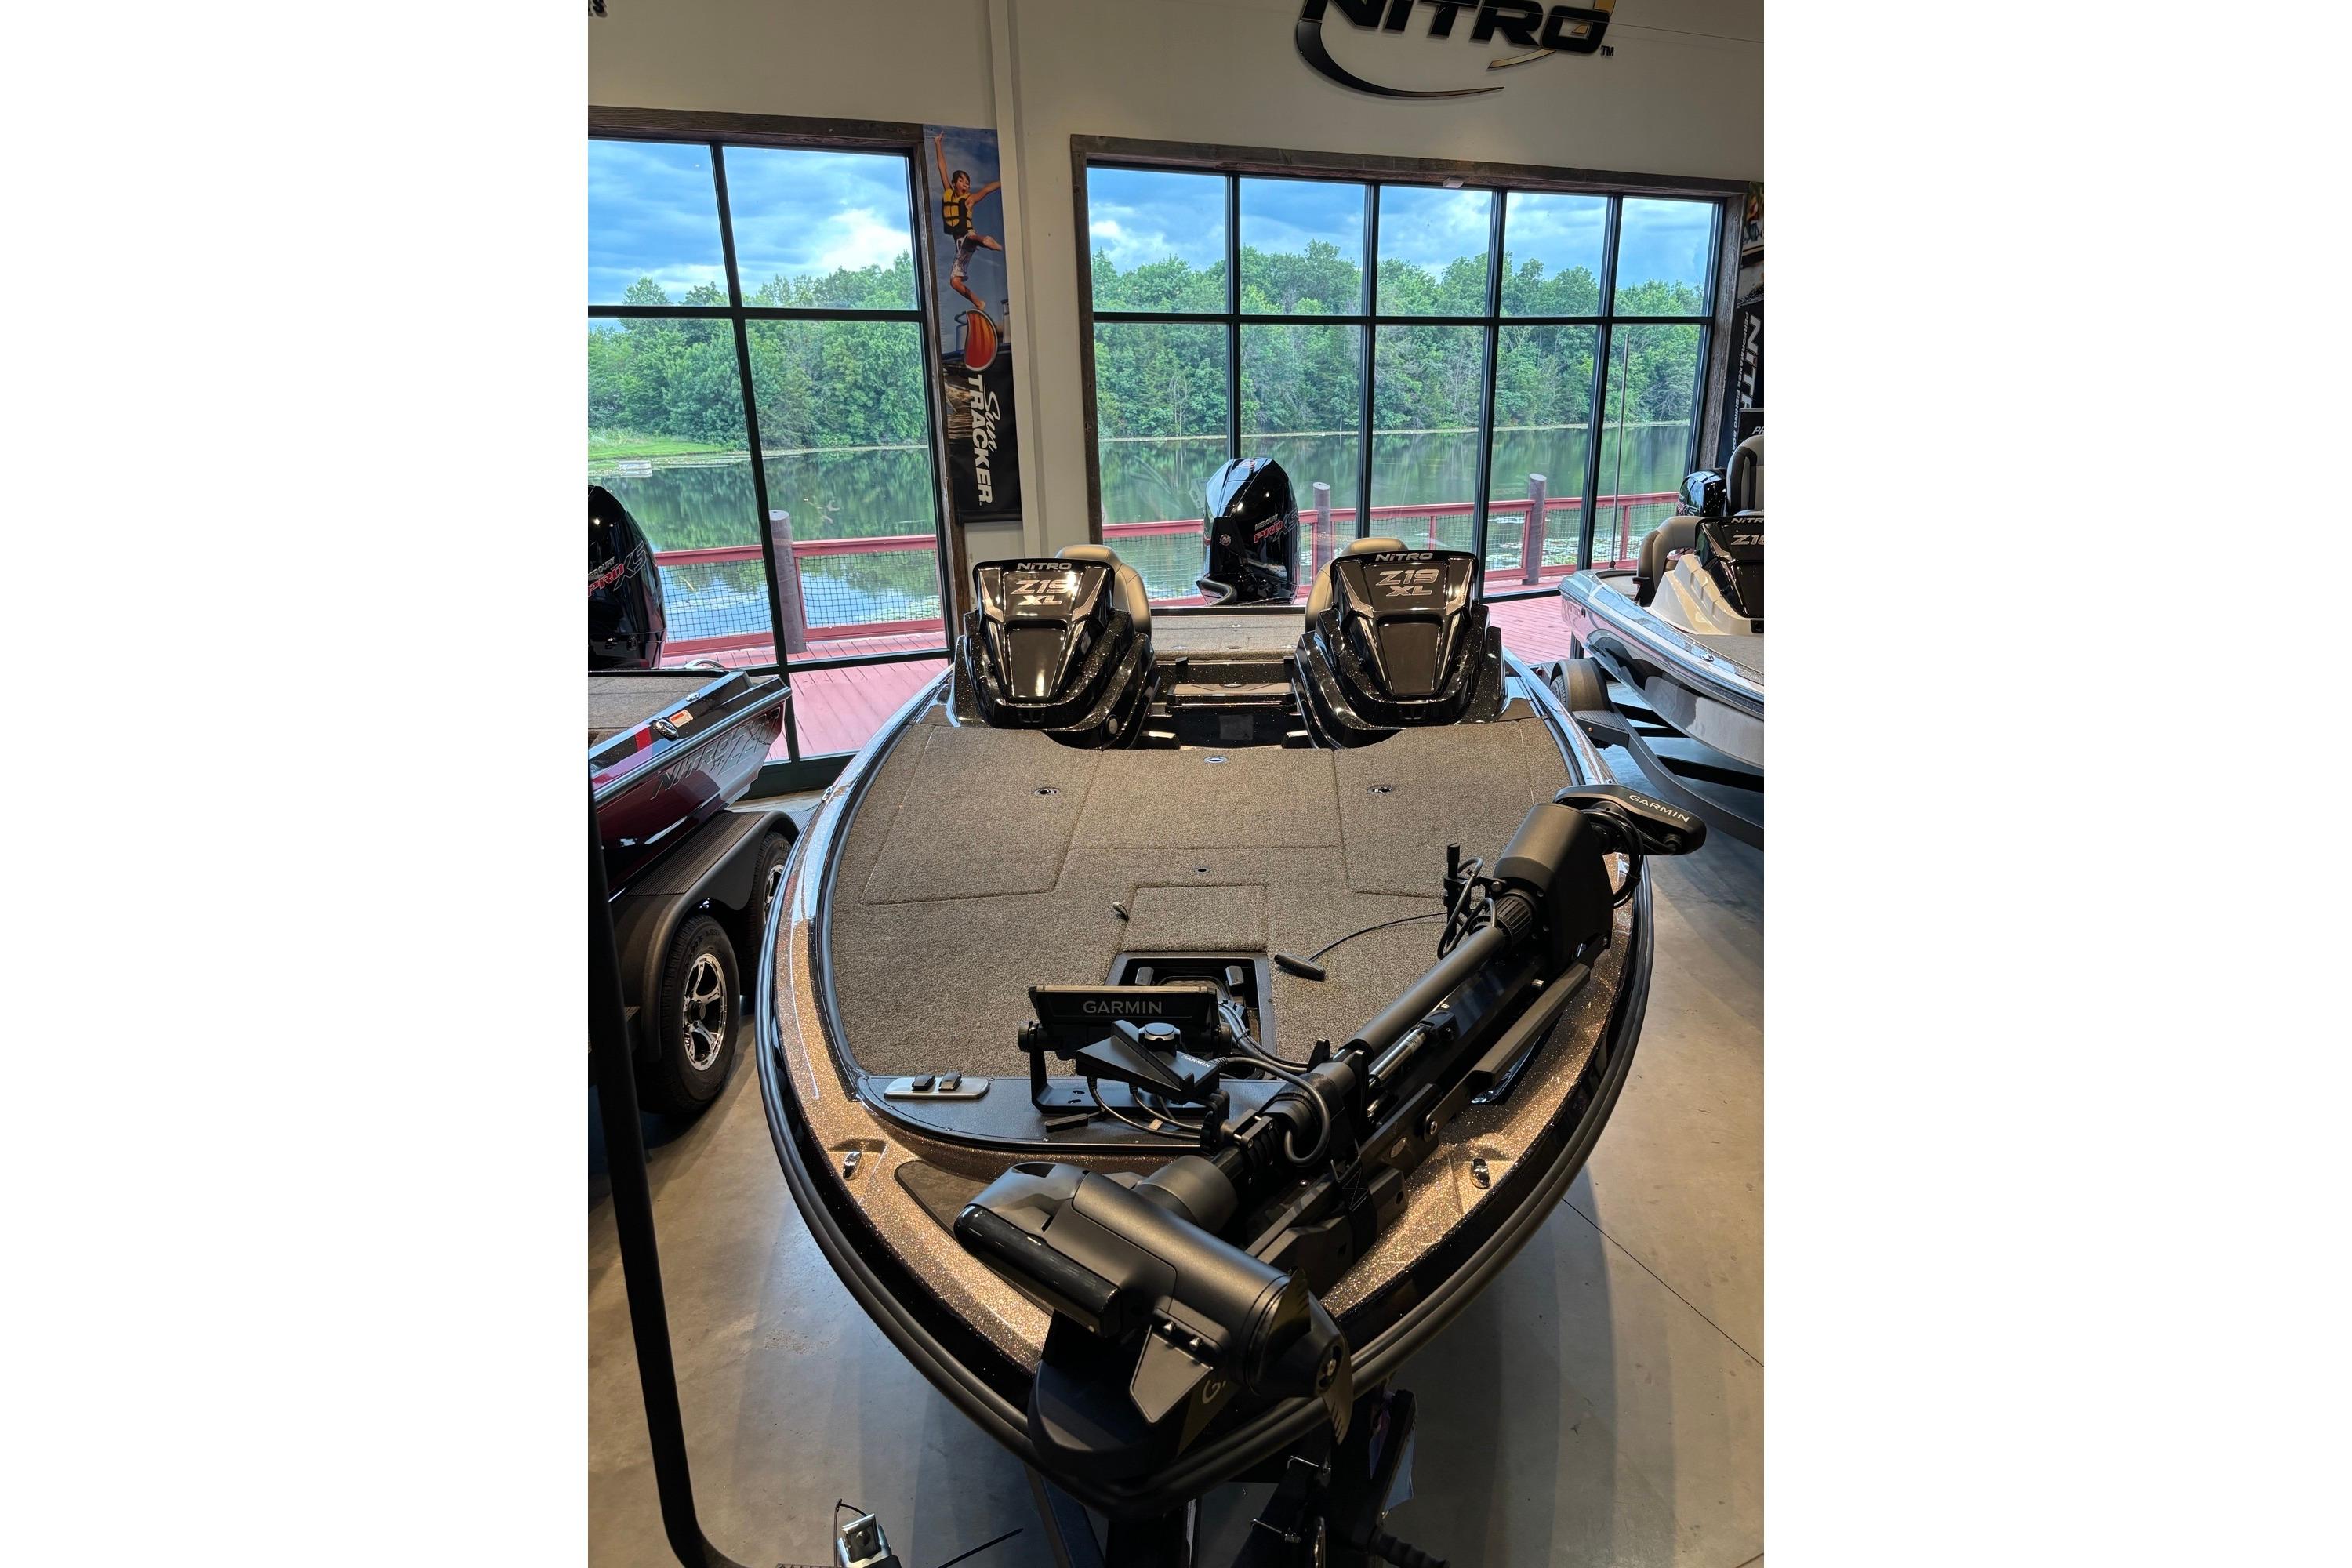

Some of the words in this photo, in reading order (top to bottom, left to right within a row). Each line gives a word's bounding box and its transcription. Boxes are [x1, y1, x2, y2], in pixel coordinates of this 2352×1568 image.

[1299, 0, 1610, 53] NITRO
[1737, 311, 1749, 388] PERFORMANCE
[984, 383, 1001, 452] Sun
[968, 374, 993, 504] TRACKER
[1254, 521, 1283, 543] PRO
[588, 563, 624, 597] PRO
[612, 540, 647, 591] XS
[1375, 552, 1433, 562] NITRO
[1376, 568, 1439, 586] Z19
[1018, 595, 1062, 605] XL
[1385, 585, 1432, 596] XL
[1629, 794, 1690, 822] GARMIN
[1083, 1000, 1162, 1014] GARMIN
